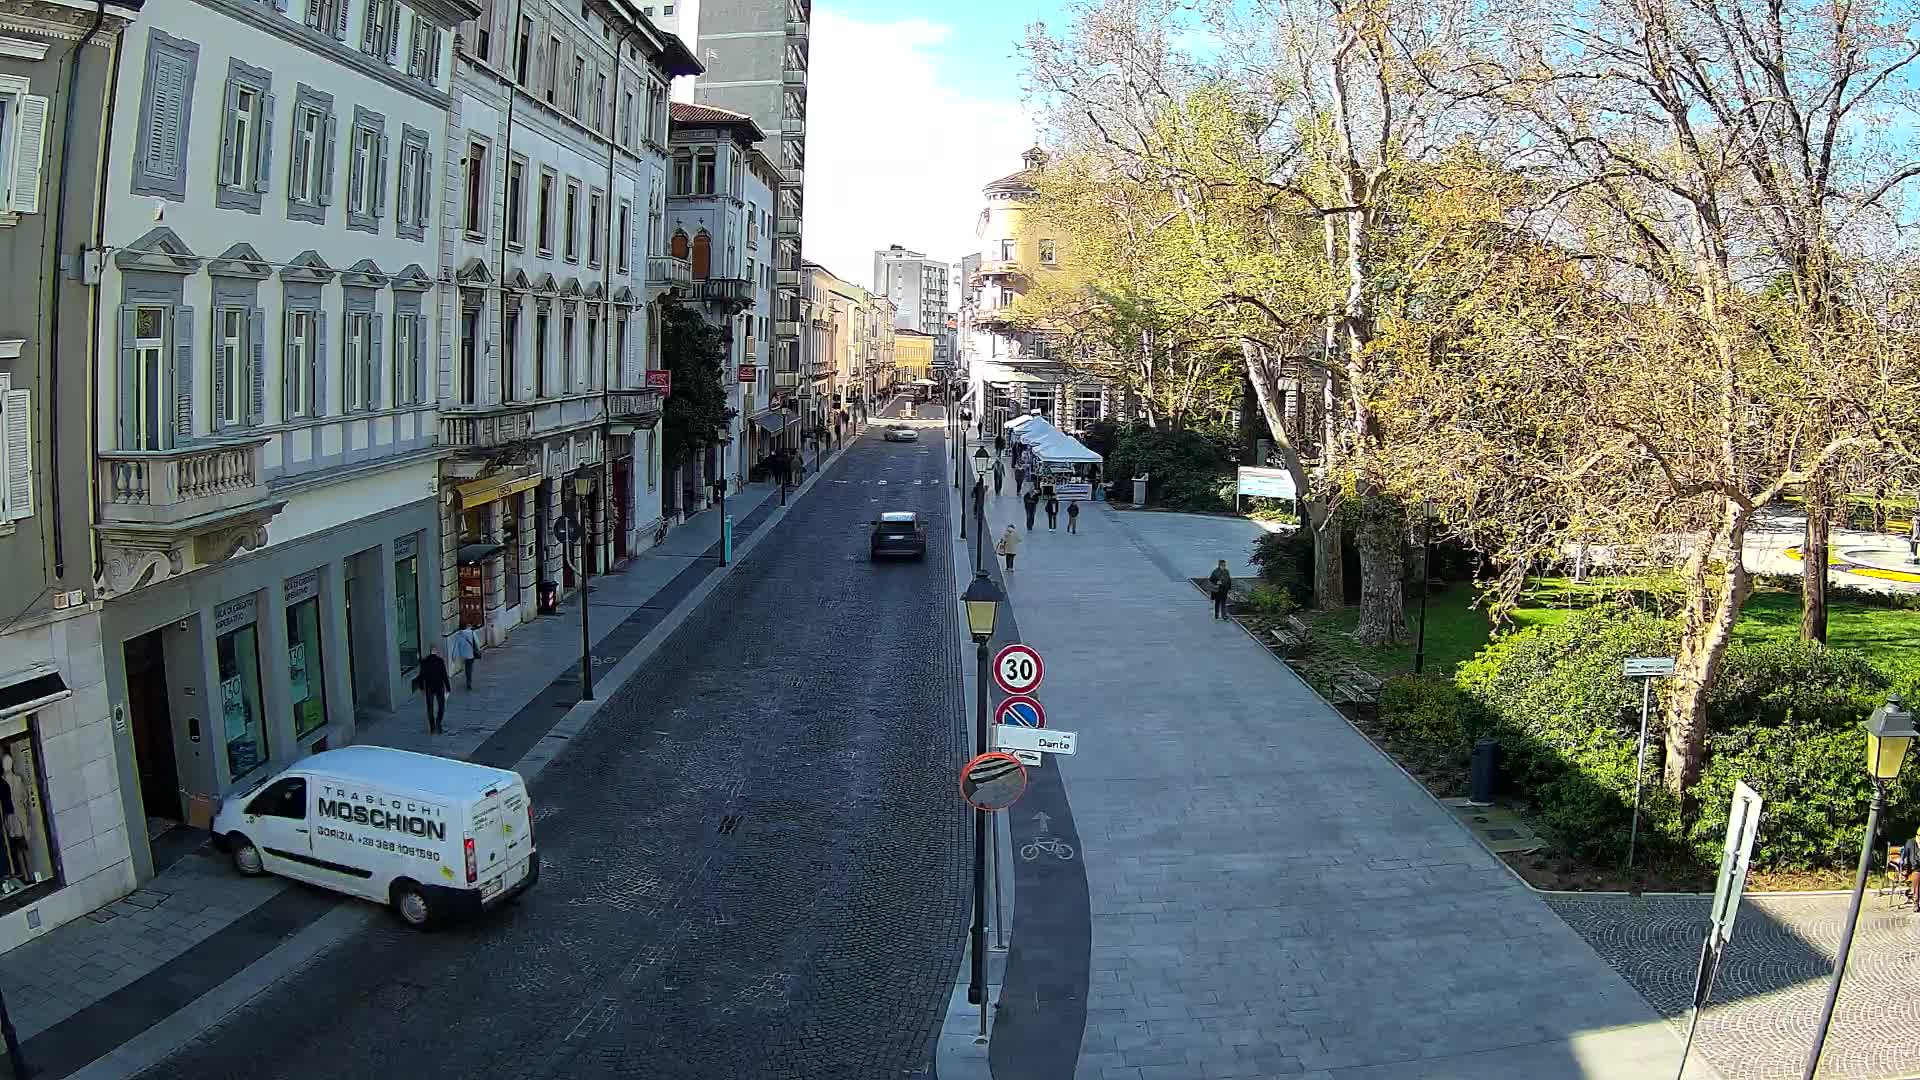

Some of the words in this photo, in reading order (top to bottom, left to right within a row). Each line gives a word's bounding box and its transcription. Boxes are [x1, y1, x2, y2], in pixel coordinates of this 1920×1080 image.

[1006, 659, 1033, 681] 30
[1038, 738, 1070, 750] Dante
[324, 785, 440, 817] TRASLOCHI
[318, 797, 447, 842] MOSCHION
[317, 825, 355, 843] GORIZIA
